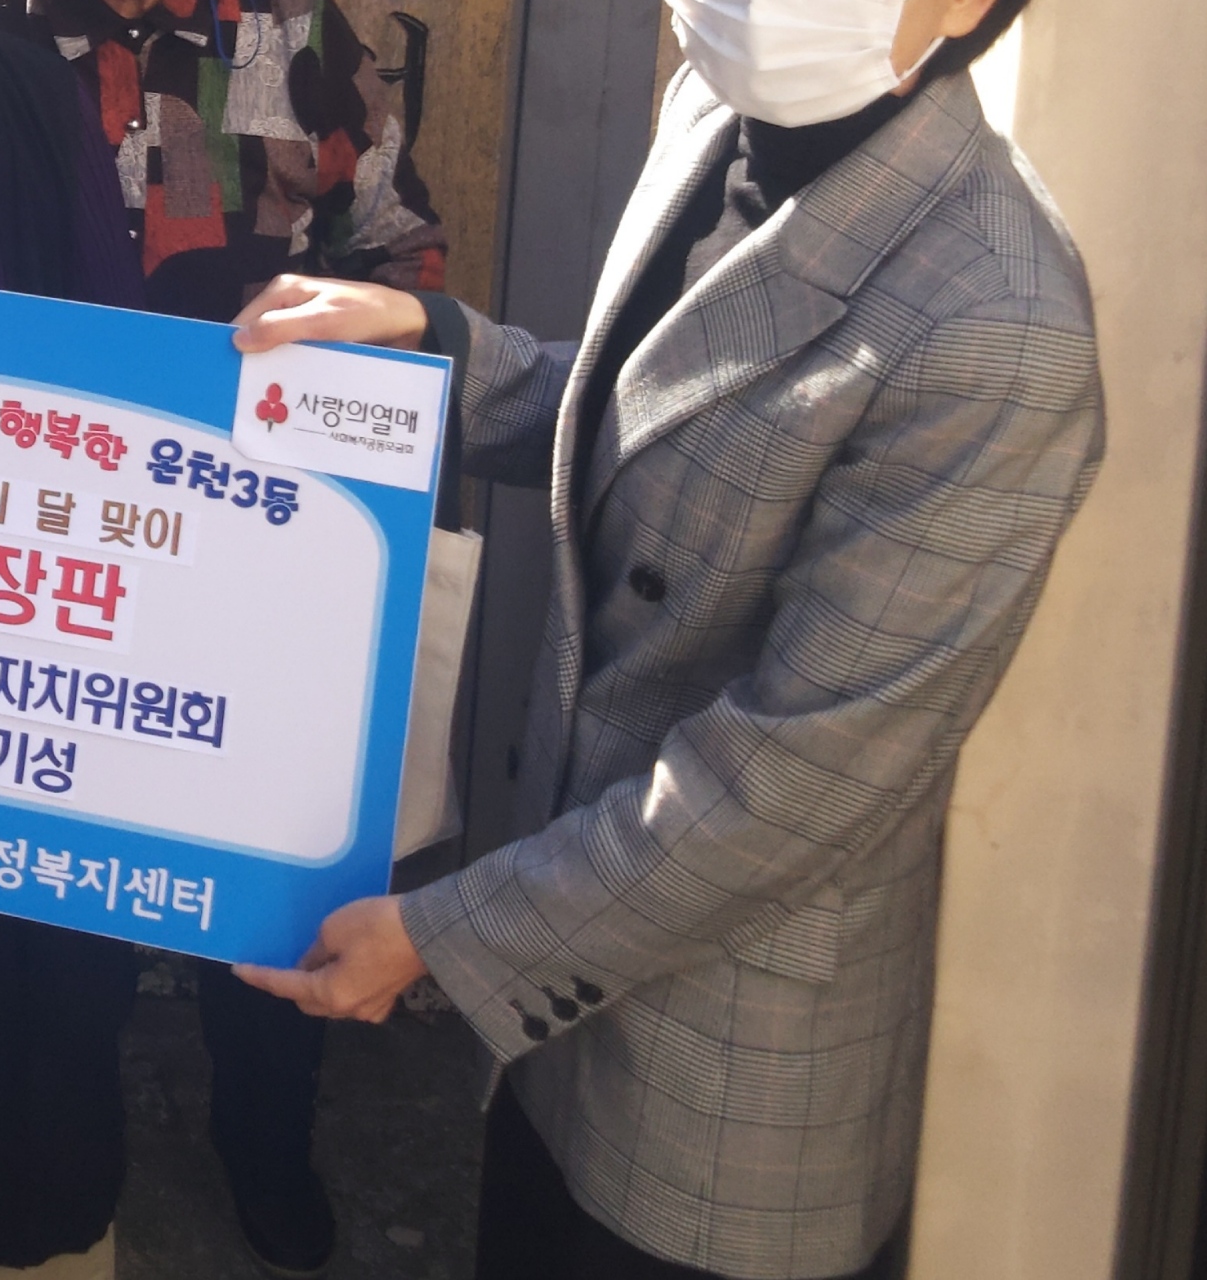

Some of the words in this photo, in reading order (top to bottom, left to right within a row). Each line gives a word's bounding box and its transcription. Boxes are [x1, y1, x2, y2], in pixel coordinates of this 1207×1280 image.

[295, 392, 419, 436] 사랑의열매
[146, 437, 300, 526] 온천3동
[35, 487, 76, 536] 달
[97, 499, 183, 557] 맞이
